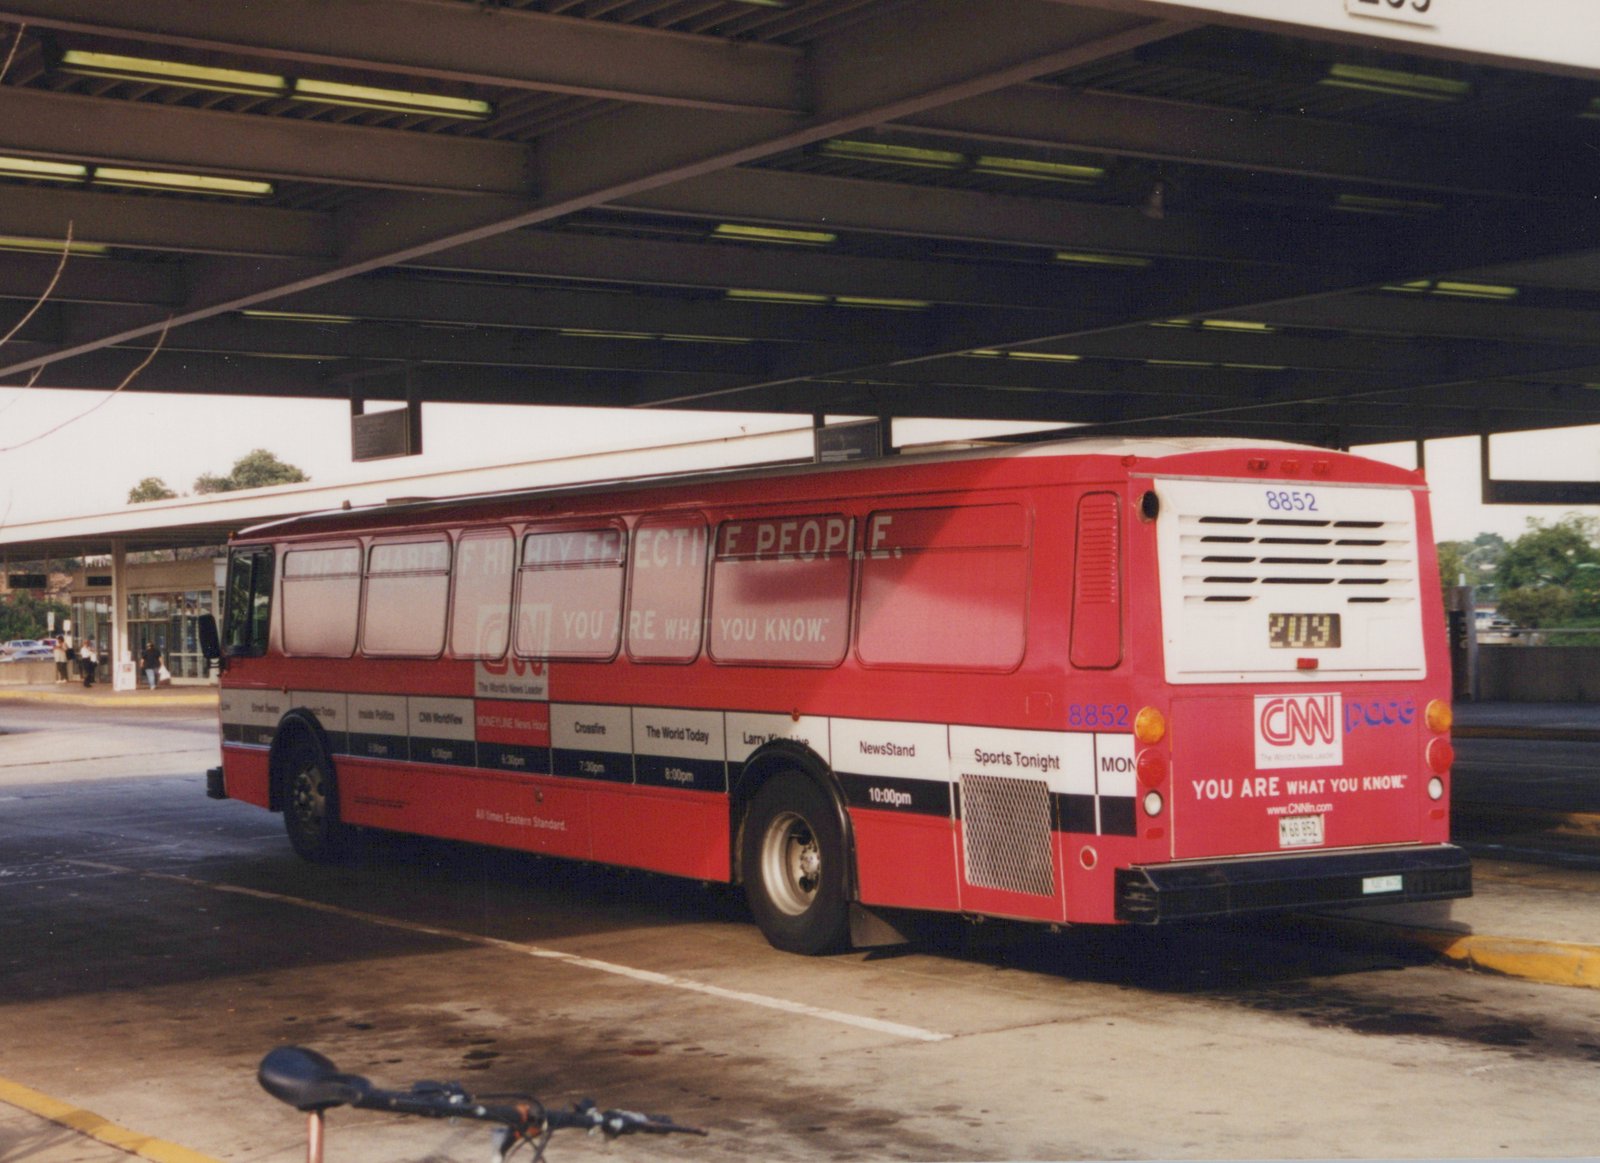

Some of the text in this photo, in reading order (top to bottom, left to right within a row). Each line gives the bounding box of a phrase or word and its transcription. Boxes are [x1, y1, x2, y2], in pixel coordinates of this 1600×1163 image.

[1266, 490, 1319, 511] 8852
[484, 535, 573, 575] HIHLY
[584, 524, 741, 569] EFECTIVE
[755, 515, 902, 563] PEOPLE.
[562, 609, 603, 640] YOU
[664, 618, 711, 641] WHA
[720, 617, 756, 641] YOU
[1068, 703, 1130, 728] 8852
[1260, 695, 1335, 747] CNN
[574, 720, 607, 735] Crossfire
[646, 725, 710, 745] The World Today
[859, 740, 916, 758] NewsStand
[974, 748, 1061, 773] Sports Tonight
[665, 767, 695, 785] 8:00pm
[868, 786, 912, 807] 10:00pm
[1191, 778, 1233, 801] YOU
[1239, 776, 1280, 799] ARE
[1286, 778, 1326, 796] WHAT
[1329, 777, 1358, 793] YOU
[505, 812, 532, 826] Eastern
